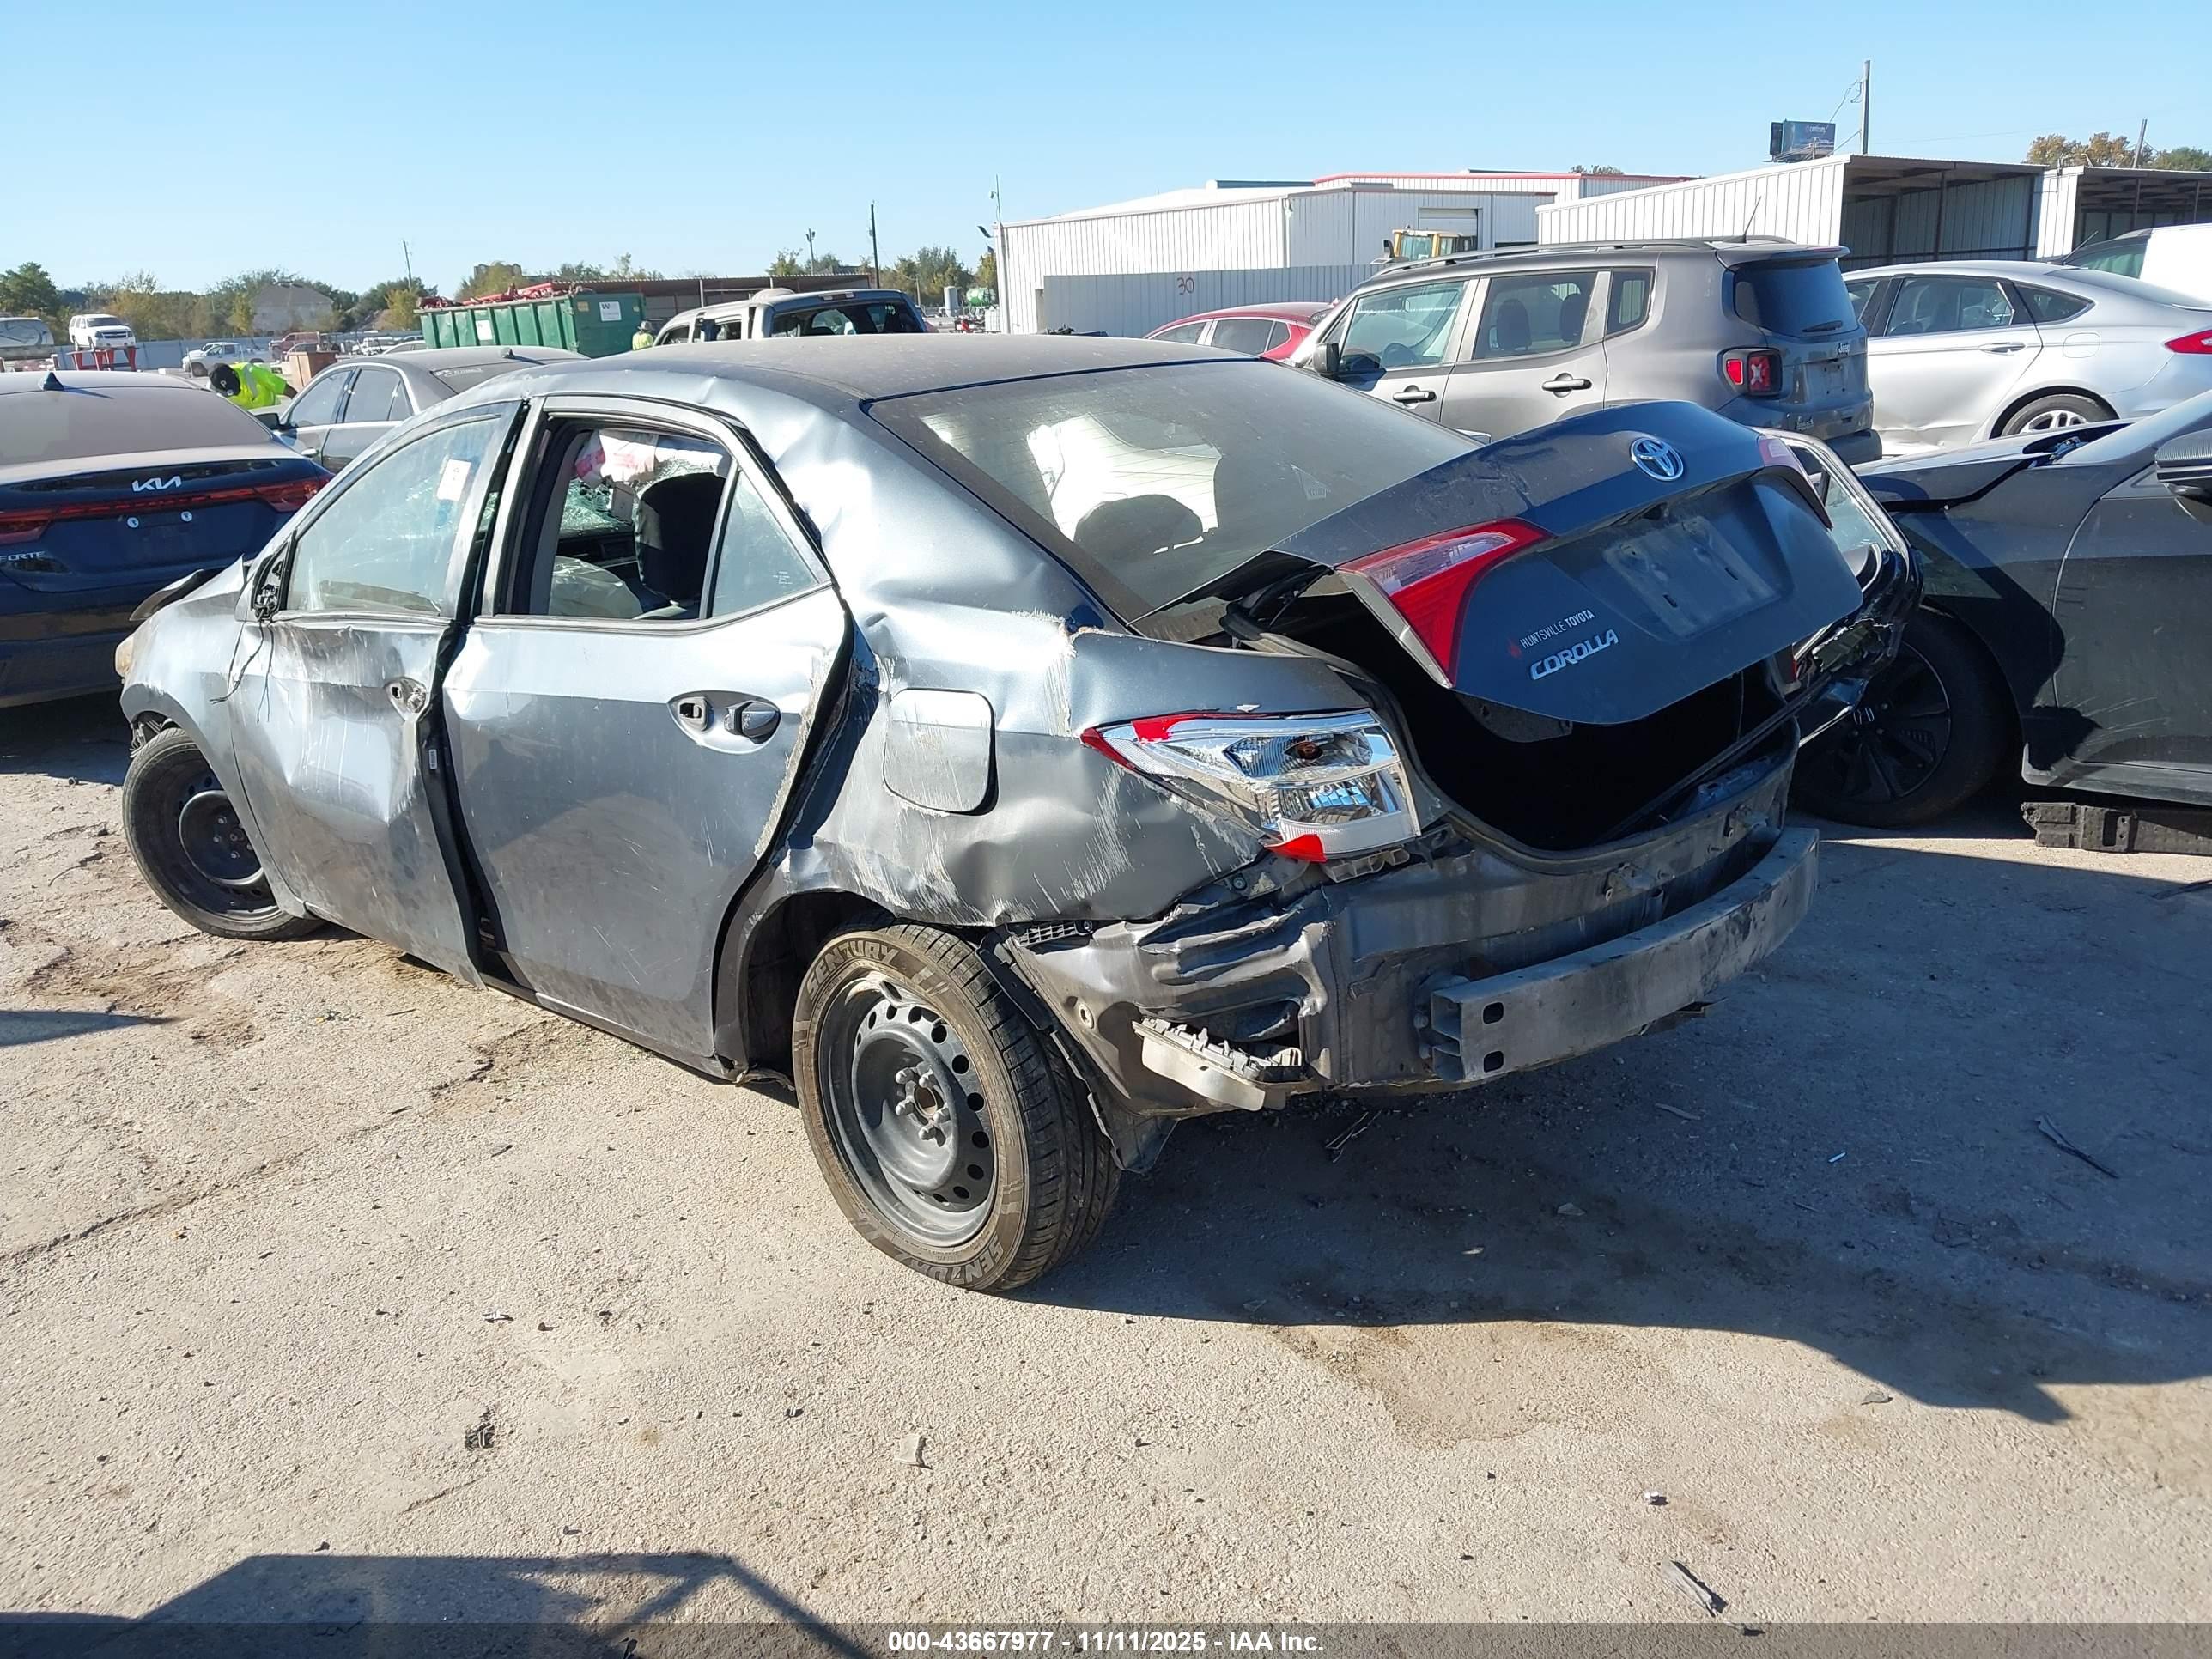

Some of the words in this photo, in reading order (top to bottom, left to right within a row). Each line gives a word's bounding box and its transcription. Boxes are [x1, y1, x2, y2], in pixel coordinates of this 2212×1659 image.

[1176, 276, 1194, 295] 30
[131, 475, 182, 493] KIA
[1520, 621, 1567, 648] HUNTSVILLE
[1565, 609, 1595, 628] TOYOTA
[1530, 629, 1619, 679] COROLLA
[807, 940, 900, 1002] SENTURY
